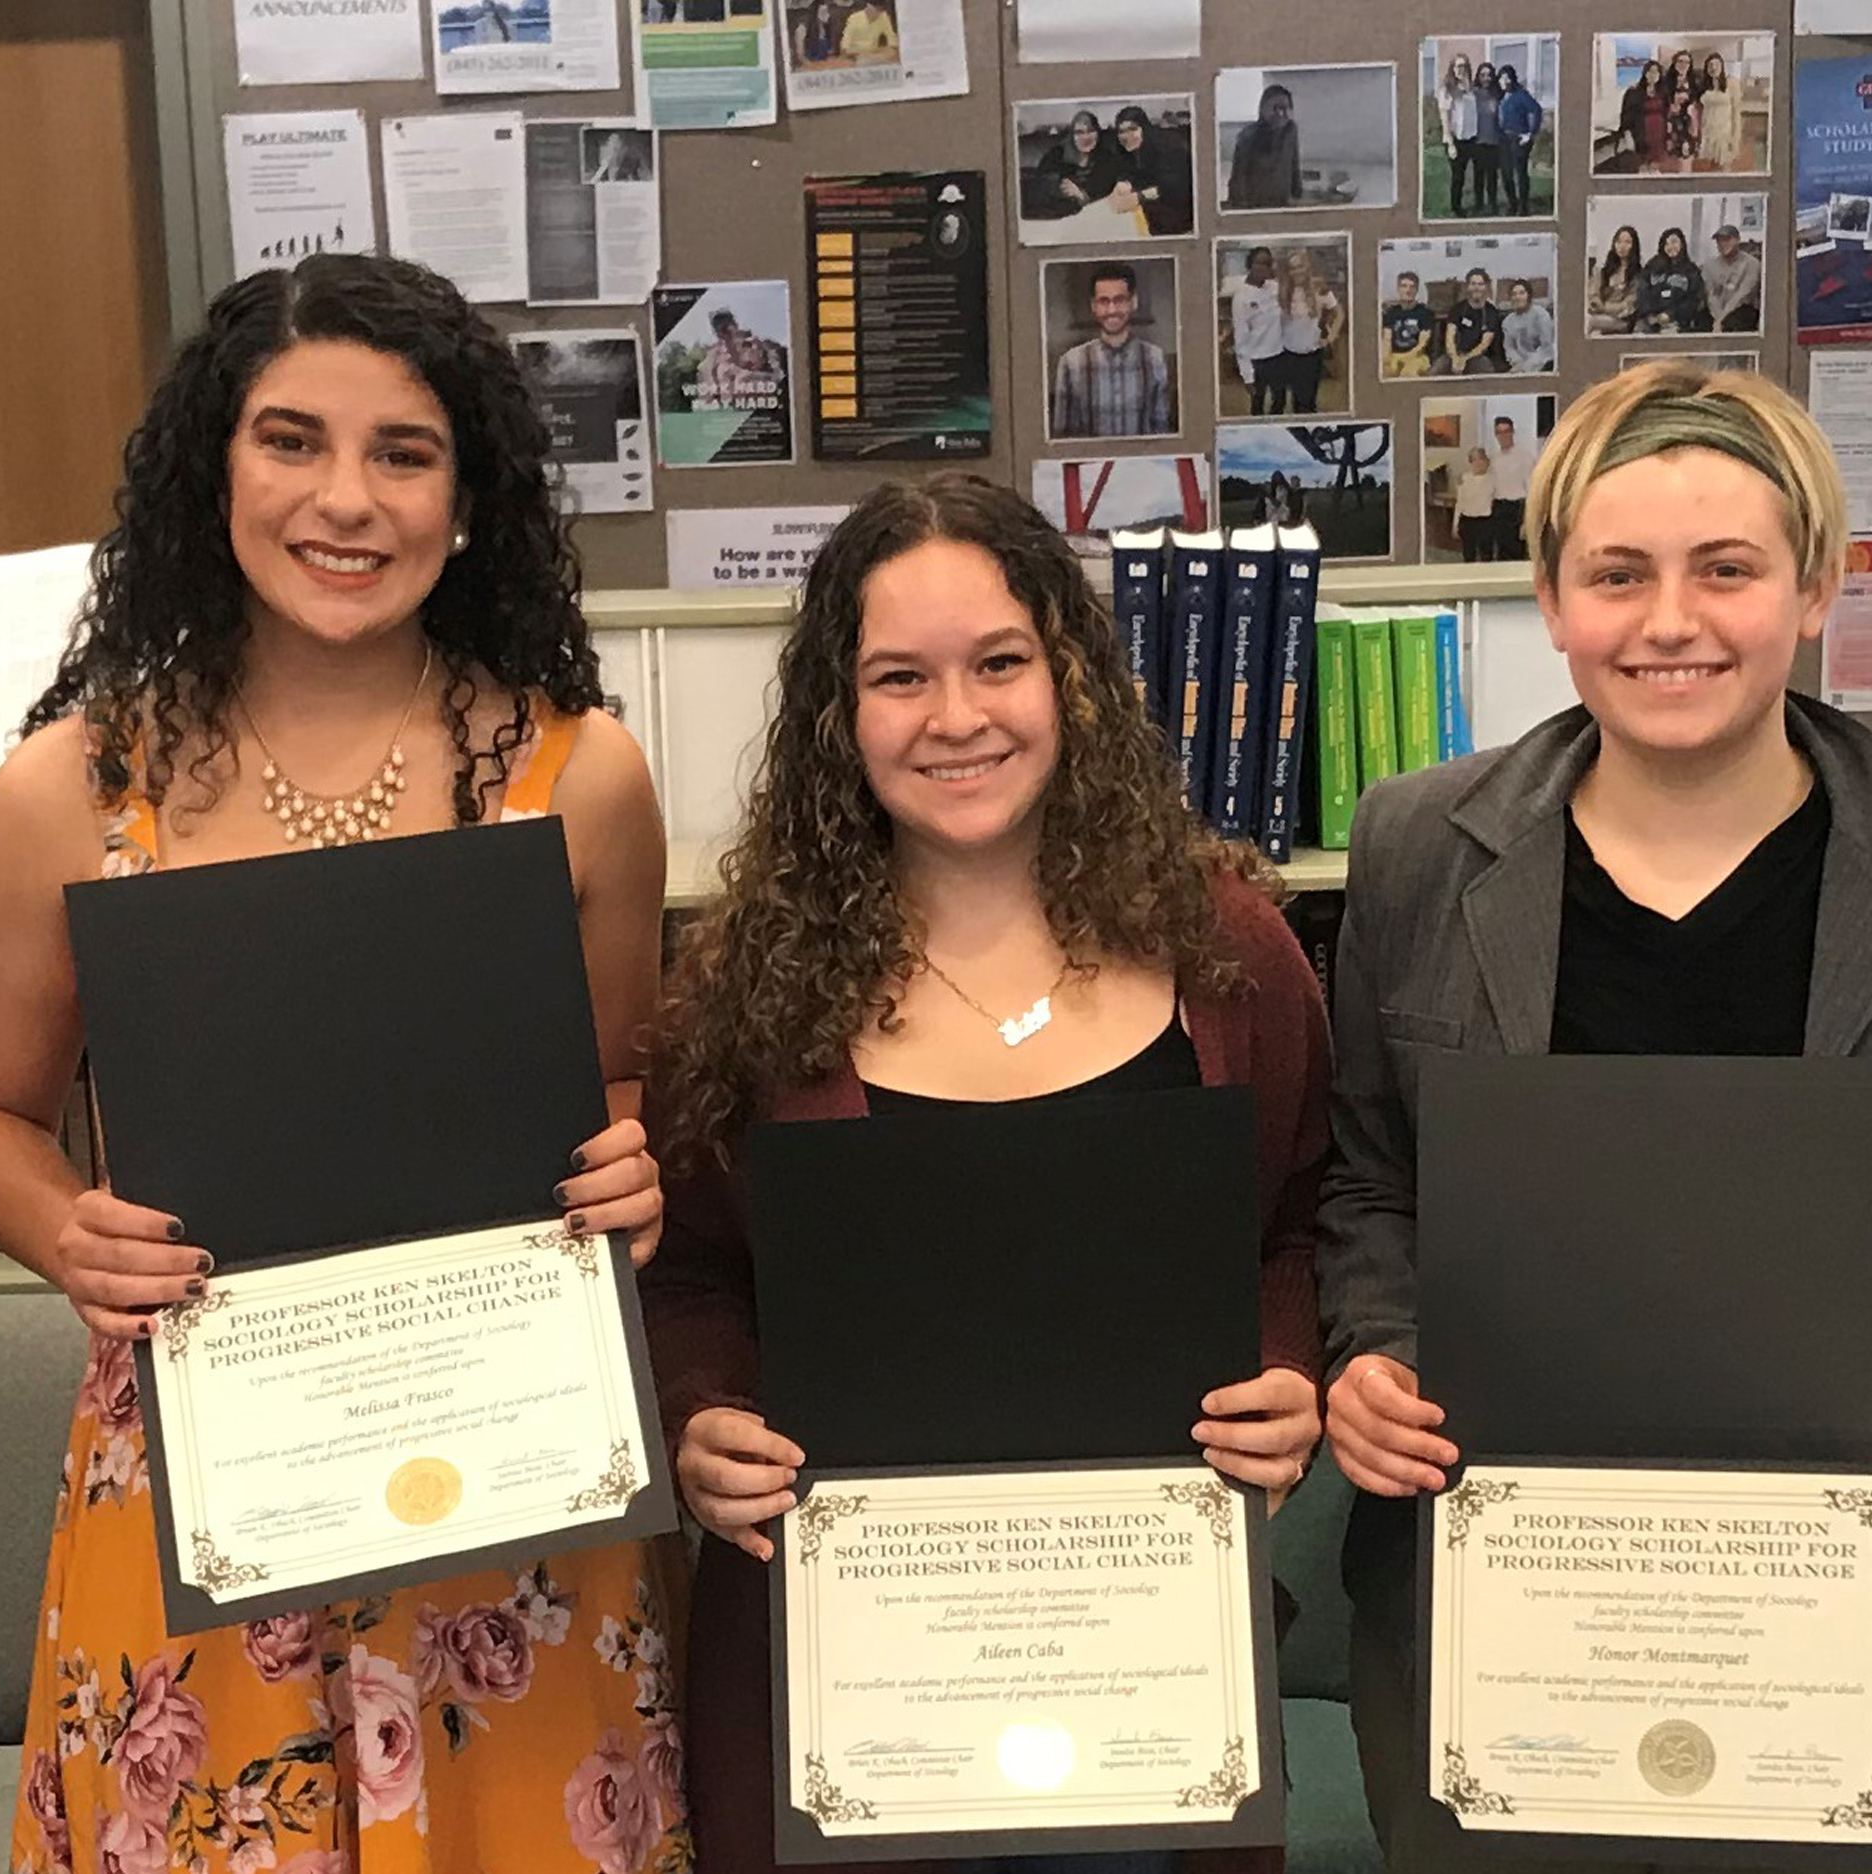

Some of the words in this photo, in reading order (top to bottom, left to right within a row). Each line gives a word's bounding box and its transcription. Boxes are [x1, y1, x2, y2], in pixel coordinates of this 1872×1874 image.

[681, 382, 729, 397] WORK
[734, 397, 784, 410] HARD.
[720, 547, 761, 562] How
[766, 549, 795, 561] are
[713, 567, 732, 580] to
[738, 566, 759, 580] be
[766, 568, 777, 578] a
[1226, 796, 1235, 816] 4
[1273, 796, 1283, 816] 5
[229, 1290, 366, 1330] PROFESSOR
[373, 1279, 419, 1299] KEN
[426, 1258, 532, 1288] SKELTON
[203, 1313, 338, 1352] SOCIOLOGY
[345, 1279, 508, 1323] SCHOLARSHIP
[514, 1269, 560, 1289] FOR
[209, 1324, 372, 1370] PROGRESSIVE
[376, 1306, 462, 1334] SOCIAL
[466, 1286, 562, 1314] CHANGE
[343, 1398, 401, 1421] Melissa
[403, 1387, 454, 1407] Frasco
[861, 1519, 999, 1539] PROFESSOR
[1006, 1516, 1053, 1533] KEN
[1058, 1512, 1167, 1530] SKELTON
[1513, 1513, 1654, 1532] PROFESSOR
[1661, 1517, 1711, 1533] KEN
[1716, 1519, 1831, 1537] SKELTON
[833, 1540, 970, 1560] SOCIOLOGY
[976, 1533, 1140, 1554] SCHOLARSHIP
[1146, 1531, 1193, 1547] FOR
[1483, 1533, 1623, 1552] SOCIOLOGY
[1629, 1538, 1801, 1557] SCHOLARSHIP
[1807, 1542, 1858, 1559] FOR
[838, 1558, 1002, 1580] PROGRESSIVE
[1006, 1555, 1091, 1572] SOCIAL
[1096, 1551, 1193, 1569] CHANGE
[1487, 1554, 1655, 1574] PROGRESSIVE
[1659, 1559, 1748, 1577] SOCIAL
[1753, 1562, 1855, 1580] CHANGE
[874, 1593, 904, 1609] Upon
[905, 1591, 922, 1604] the
[923, 1587, 1005, 1603] recommendation
[1019, 1587, 1036, 1599] the
[1037, 1586, 1098, 1602] Department
[1112, 1581, 1161, 1598] Sociology
[942, 1604, 982, 1620] faculty
[982, 1601, 1039, 1617] scholarship
[1039, 1602, 1091, 1614] committee
[925, 1618, 978, 1635] Honorable
[980, 1620, 1024, 1632] Mention
[1035, 1615, 1086, 1631] conferred
[1084, 1618, 1111, 1630] upon
[973, 1642, 1022, 1663] Aileen
[1026, 1639, 1065, 1660] Caba
[1587, 1644, 1641, 1663] Honor
[831, 1679, 852, 1692] For
[852, 1677, 897, 1692] excellent
[898, 1675, 943, 1689] academic
[945, 1673, 1007, 1690] performance
[1008, 1670, 1030, 1685] and
[1030, 1670, 1047, 1683] the
[1048, 1669, 1106, 1686] application
[1121, 1664, 1178, 1681] sociological
[1177, 1663, 1209, 1677] ideals
[917, 1691, 934, 1704] the
[934, 1690, 1001, 1703] advancement
[1015, 1688, 1071, 1703] progressive
[1073, 1683, 1103, 1698] social
[1103, 1682, 1139, 1698] change
